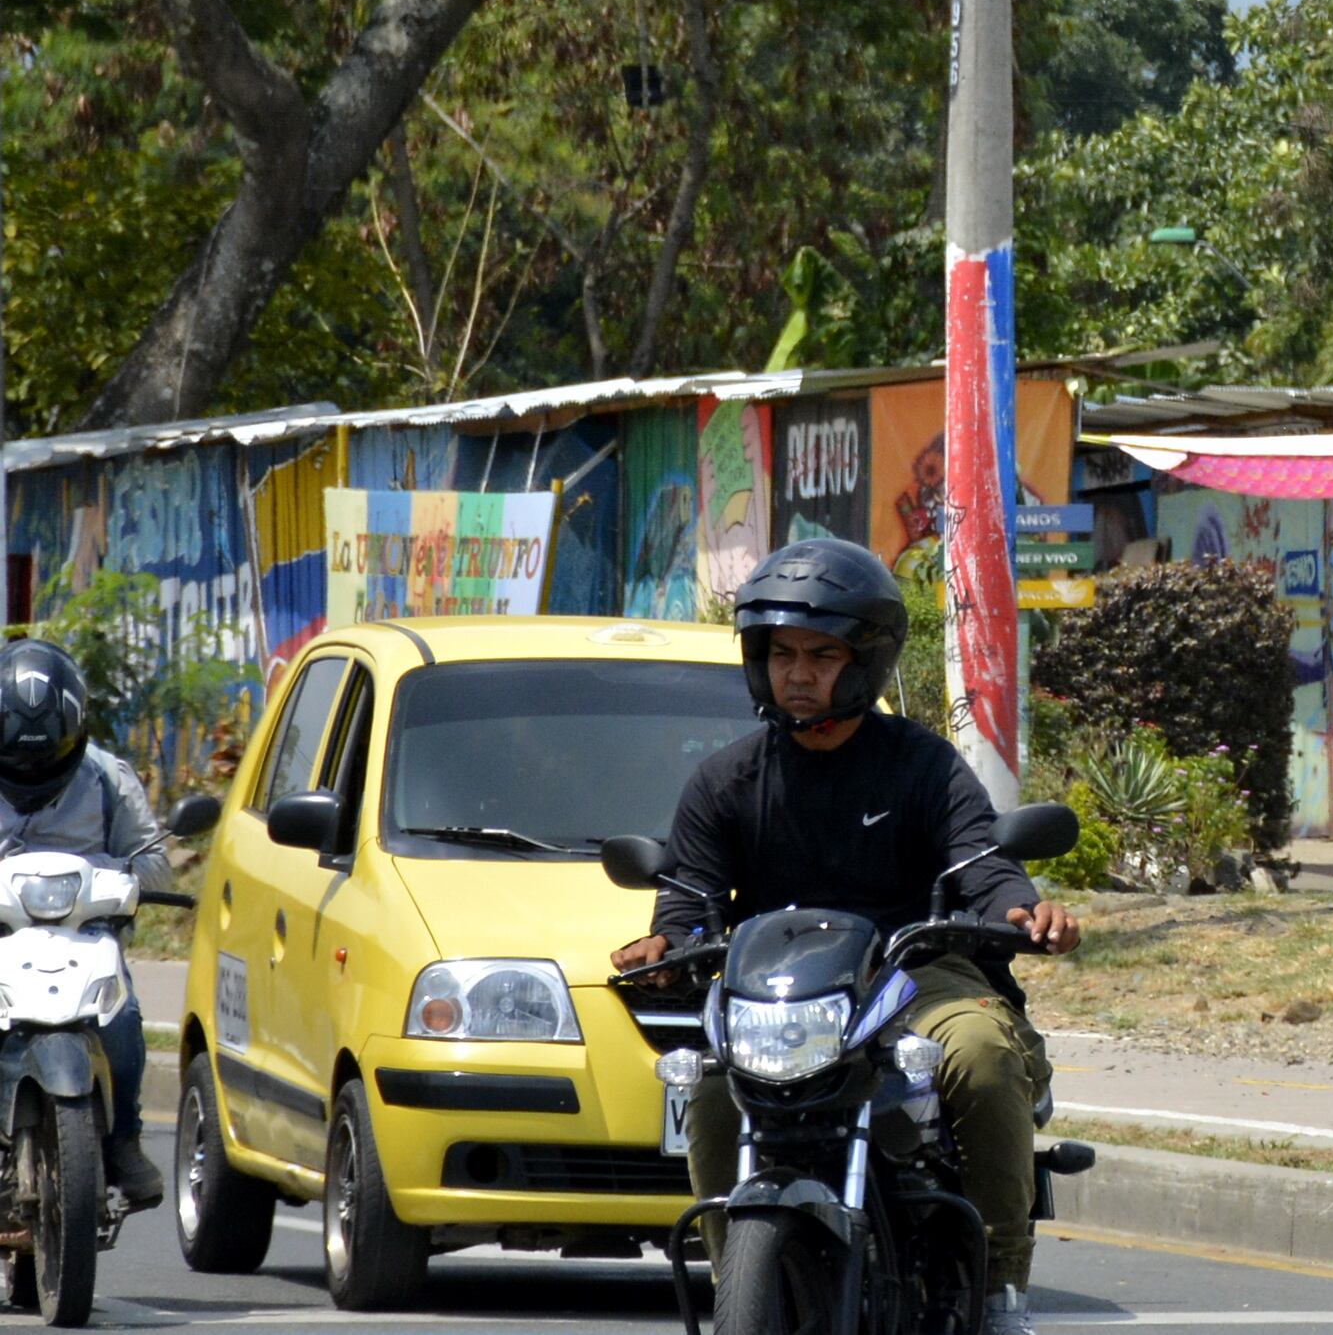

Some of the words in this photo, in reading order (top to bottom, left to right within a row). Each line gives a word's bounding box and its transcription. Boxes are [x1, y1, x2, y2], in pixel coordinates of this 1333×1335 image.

[785, 417, 859, 502] PUERTO
[1016, 513, 1062, 526] ANOS
[456, 537, 541, 579] TRIUNFO
[1016, 553, 1042, 564] NER
[1045, 552, 1078, 564] VIVO
